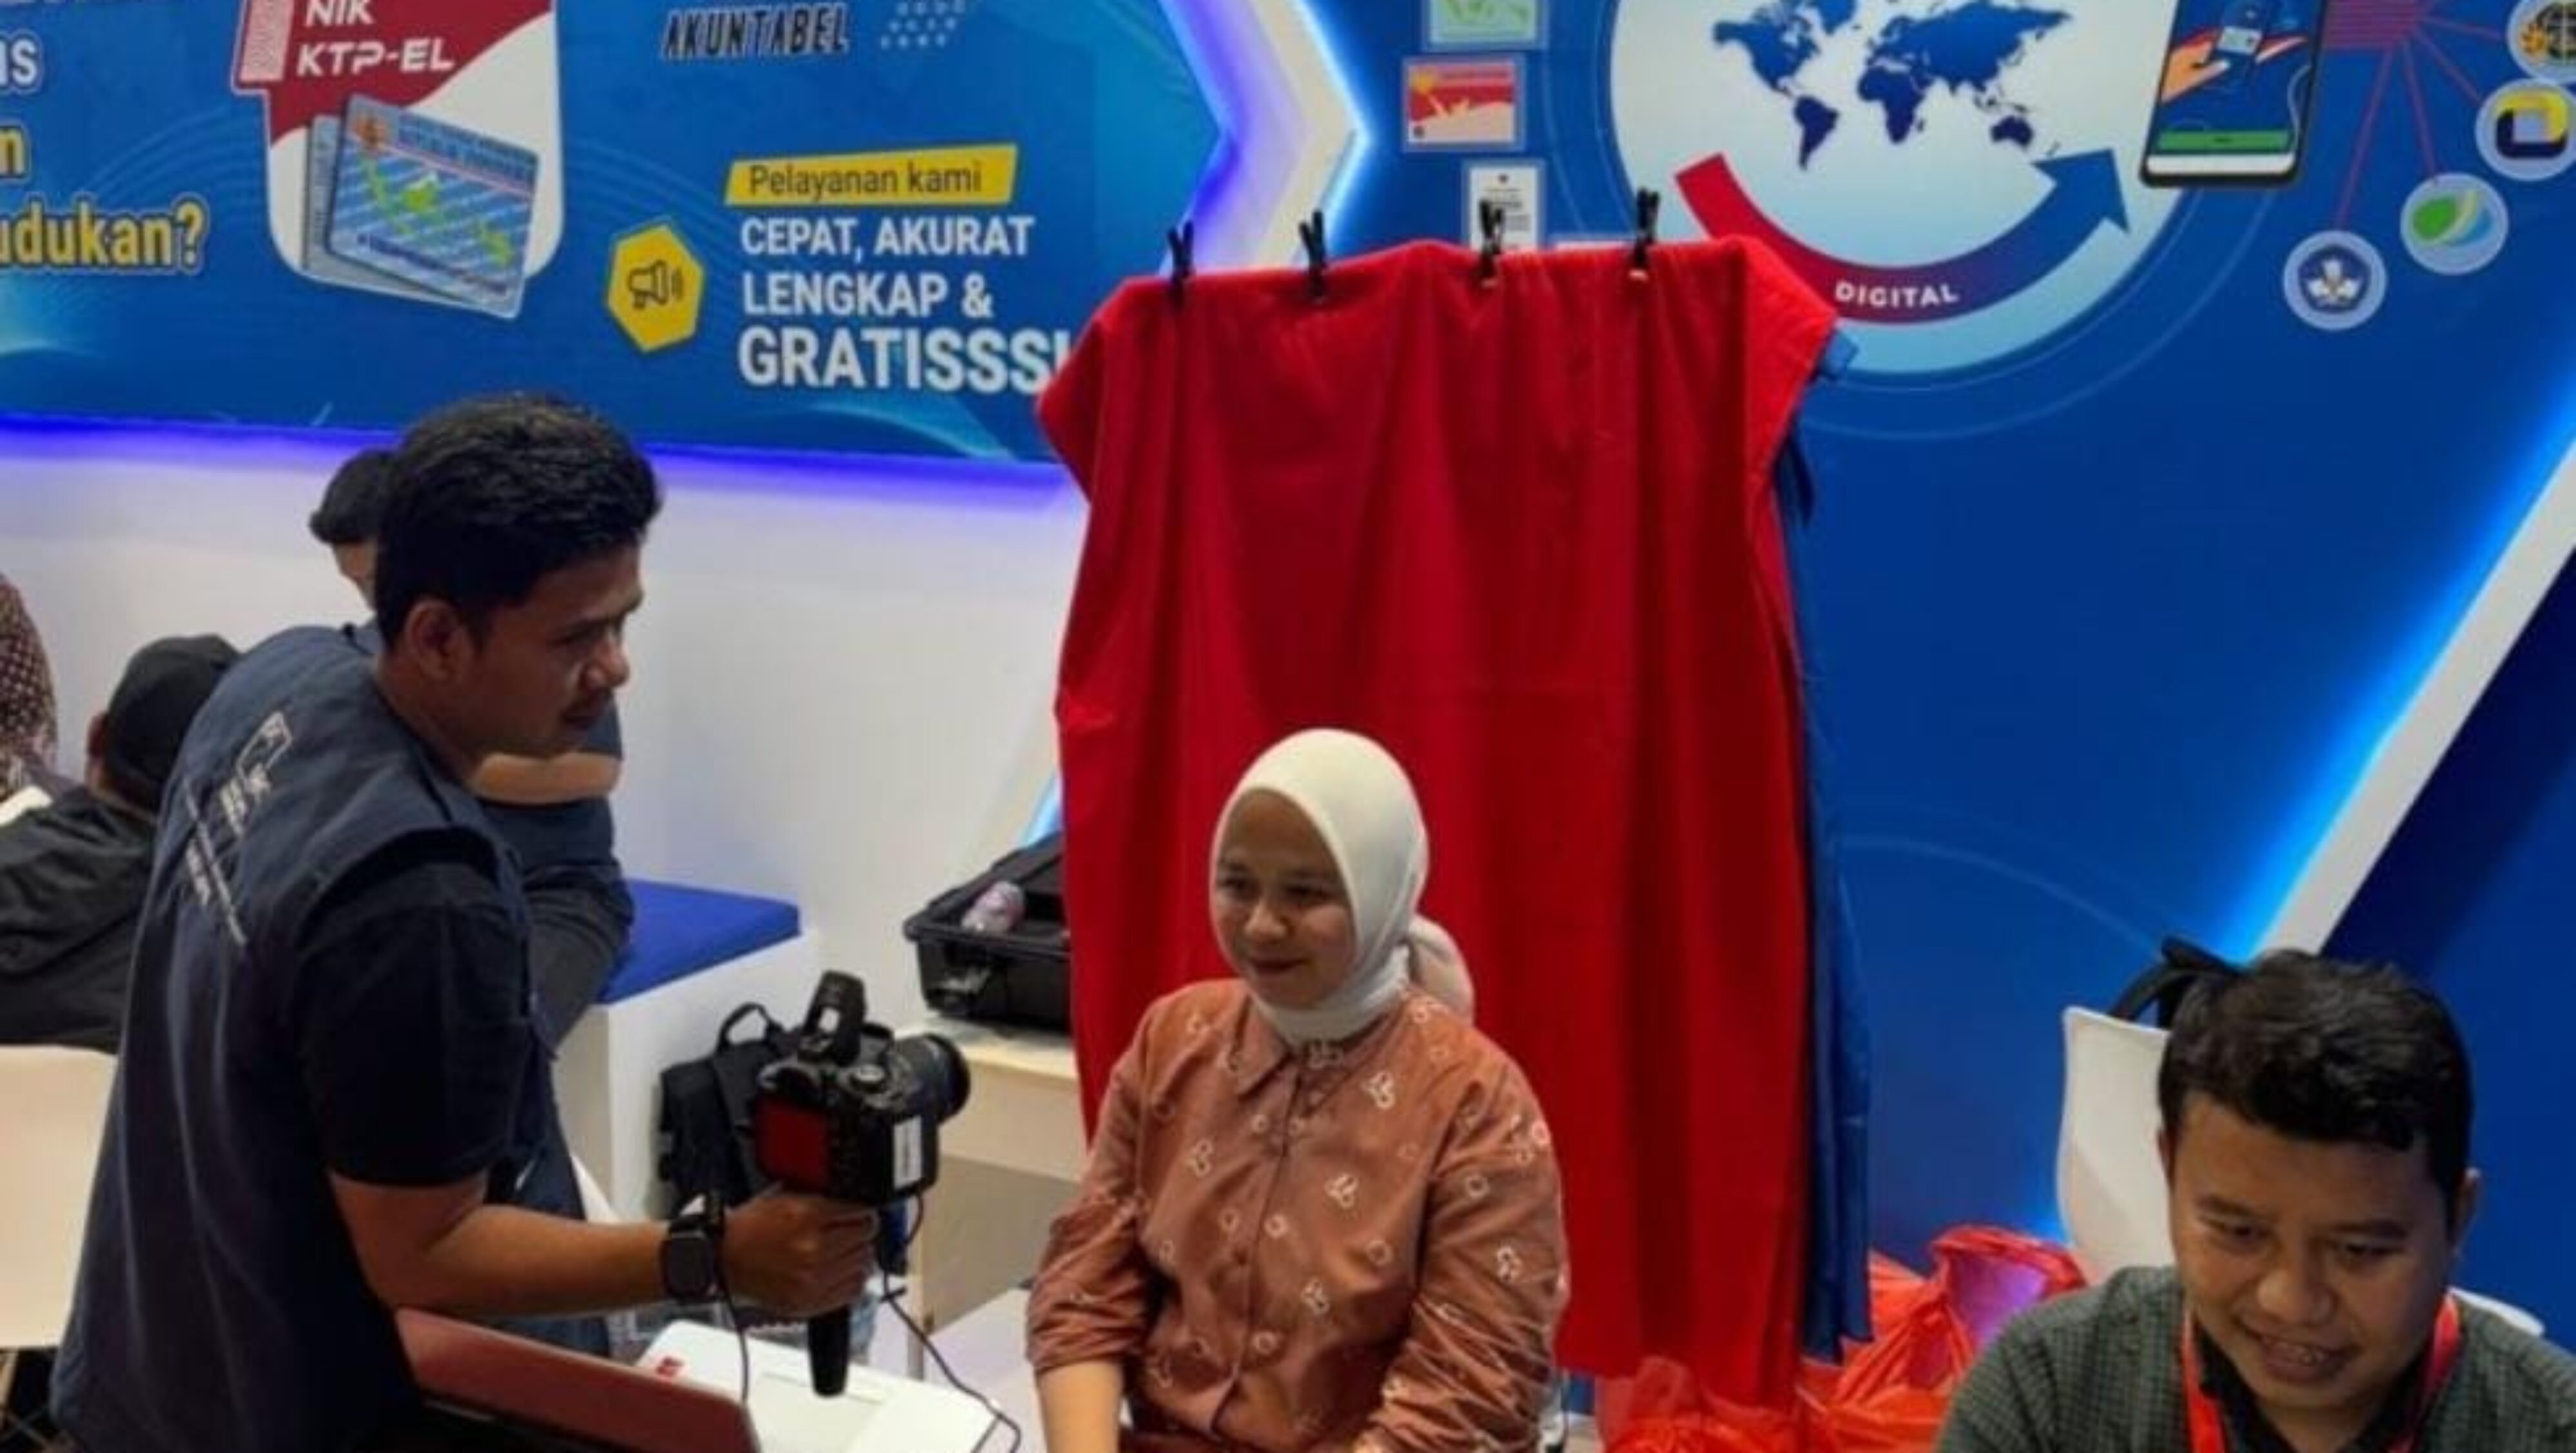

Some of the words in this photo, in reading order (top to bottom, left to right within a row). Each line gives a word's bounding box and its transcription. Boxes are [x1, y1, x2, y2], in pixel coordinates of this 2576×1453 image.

[304, 0, 375, 28] NIK
[663, 5, 849, 58] AKUNTABEL
[296, 36, 455, 77] KTP-EL
[749, 163, 898, 202] Pelayanan
[907, 160, 983, 193] kami
[741, 216, 862, 265] CEPAT,
[873, 214, 1035, 256] AKURAT
[741, 271, 949, 318] LENGKAP
[961, 271, 995, 318] &
[1835, 279, 1960, 309] DIGITAL
